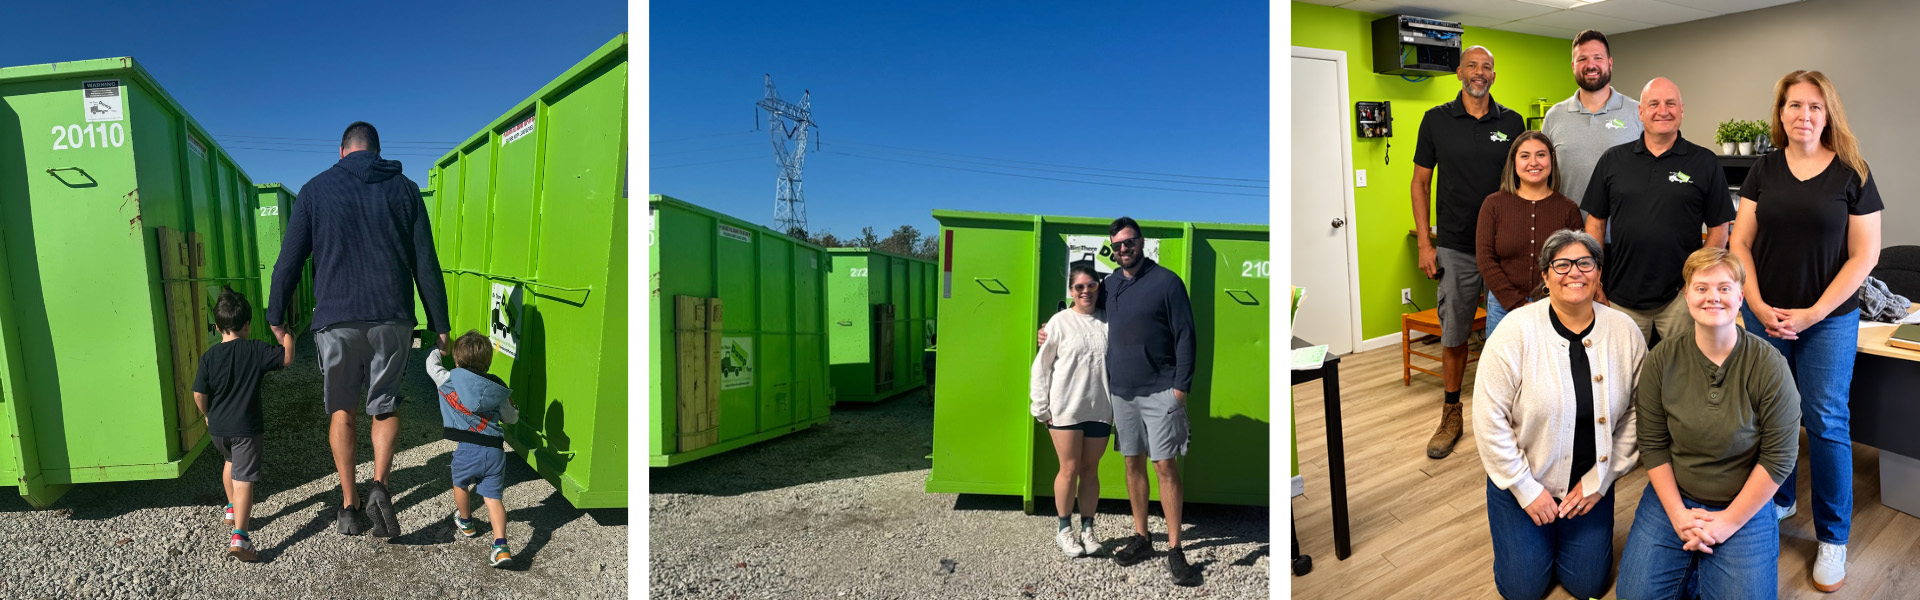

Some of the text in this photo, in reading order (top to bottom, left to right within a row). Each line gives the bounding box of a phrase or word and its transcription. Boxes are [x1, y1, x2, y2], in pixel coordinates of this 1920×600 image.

[51, 122, 124, 150] 20110
[260, 205, 279, 217] 272
[850, 267, 868, 277] 272
[1241, 260, 1270, 278] 210
